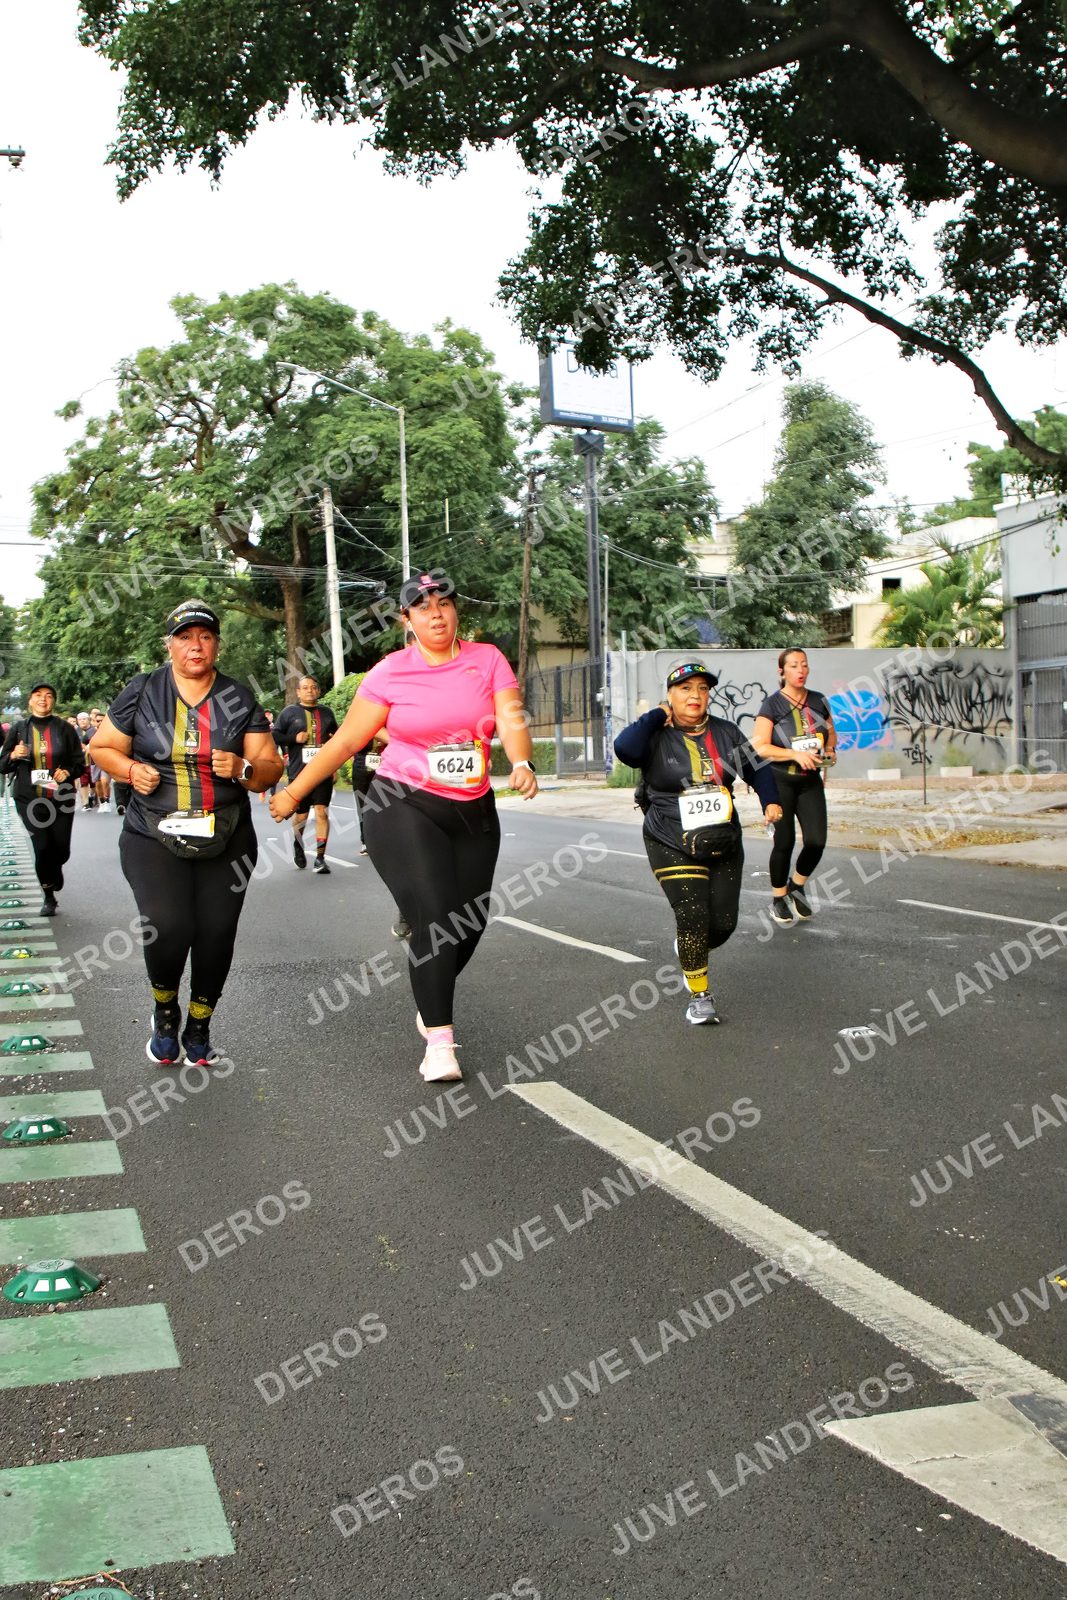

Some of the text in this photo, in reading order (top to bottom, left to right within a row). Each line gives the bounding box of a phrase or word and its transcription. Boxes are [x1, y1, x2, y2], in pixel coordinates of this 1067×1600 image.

[670, 665, 693, 681] FUCK
[437, 757, 474, 774] 6624
[687, 798, 721, 815] 2926
